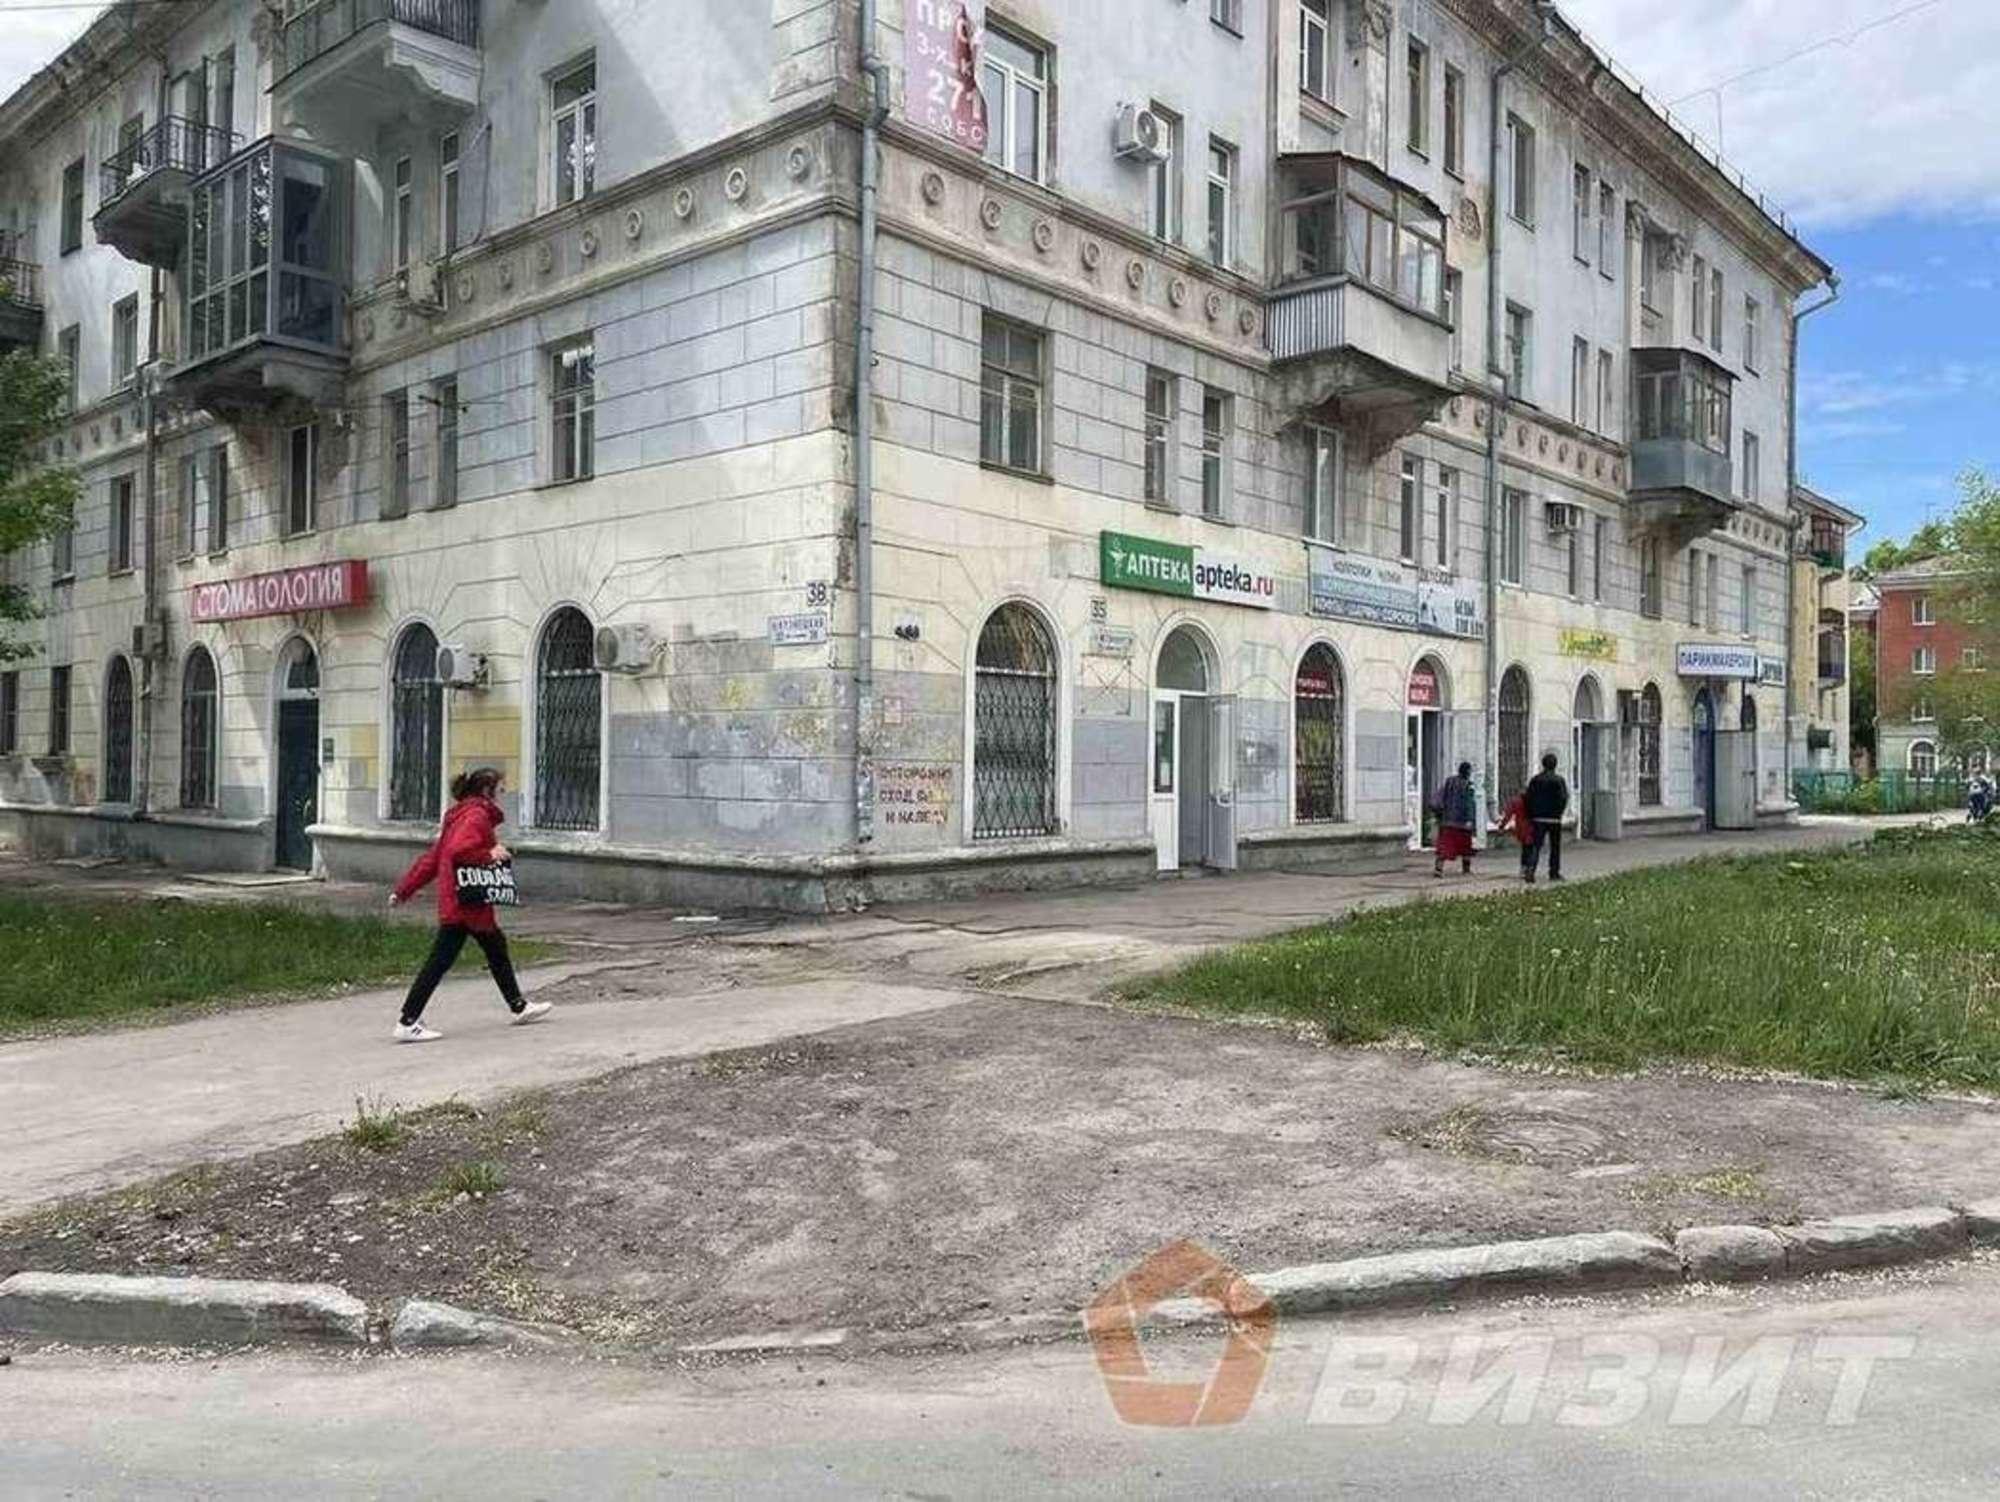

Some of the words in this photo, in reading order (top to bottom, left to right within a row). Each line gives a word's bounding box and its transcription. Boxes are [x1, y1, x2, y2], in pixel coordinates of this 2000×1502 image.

[1126, 552, 1191, 584] АПТЕКА
[1195, 562, 1274, 596] apteka.ru
[197, 566, 342, 617] СТОМАТОЛОГИЯ
[807, 582, 827, 603] 38
